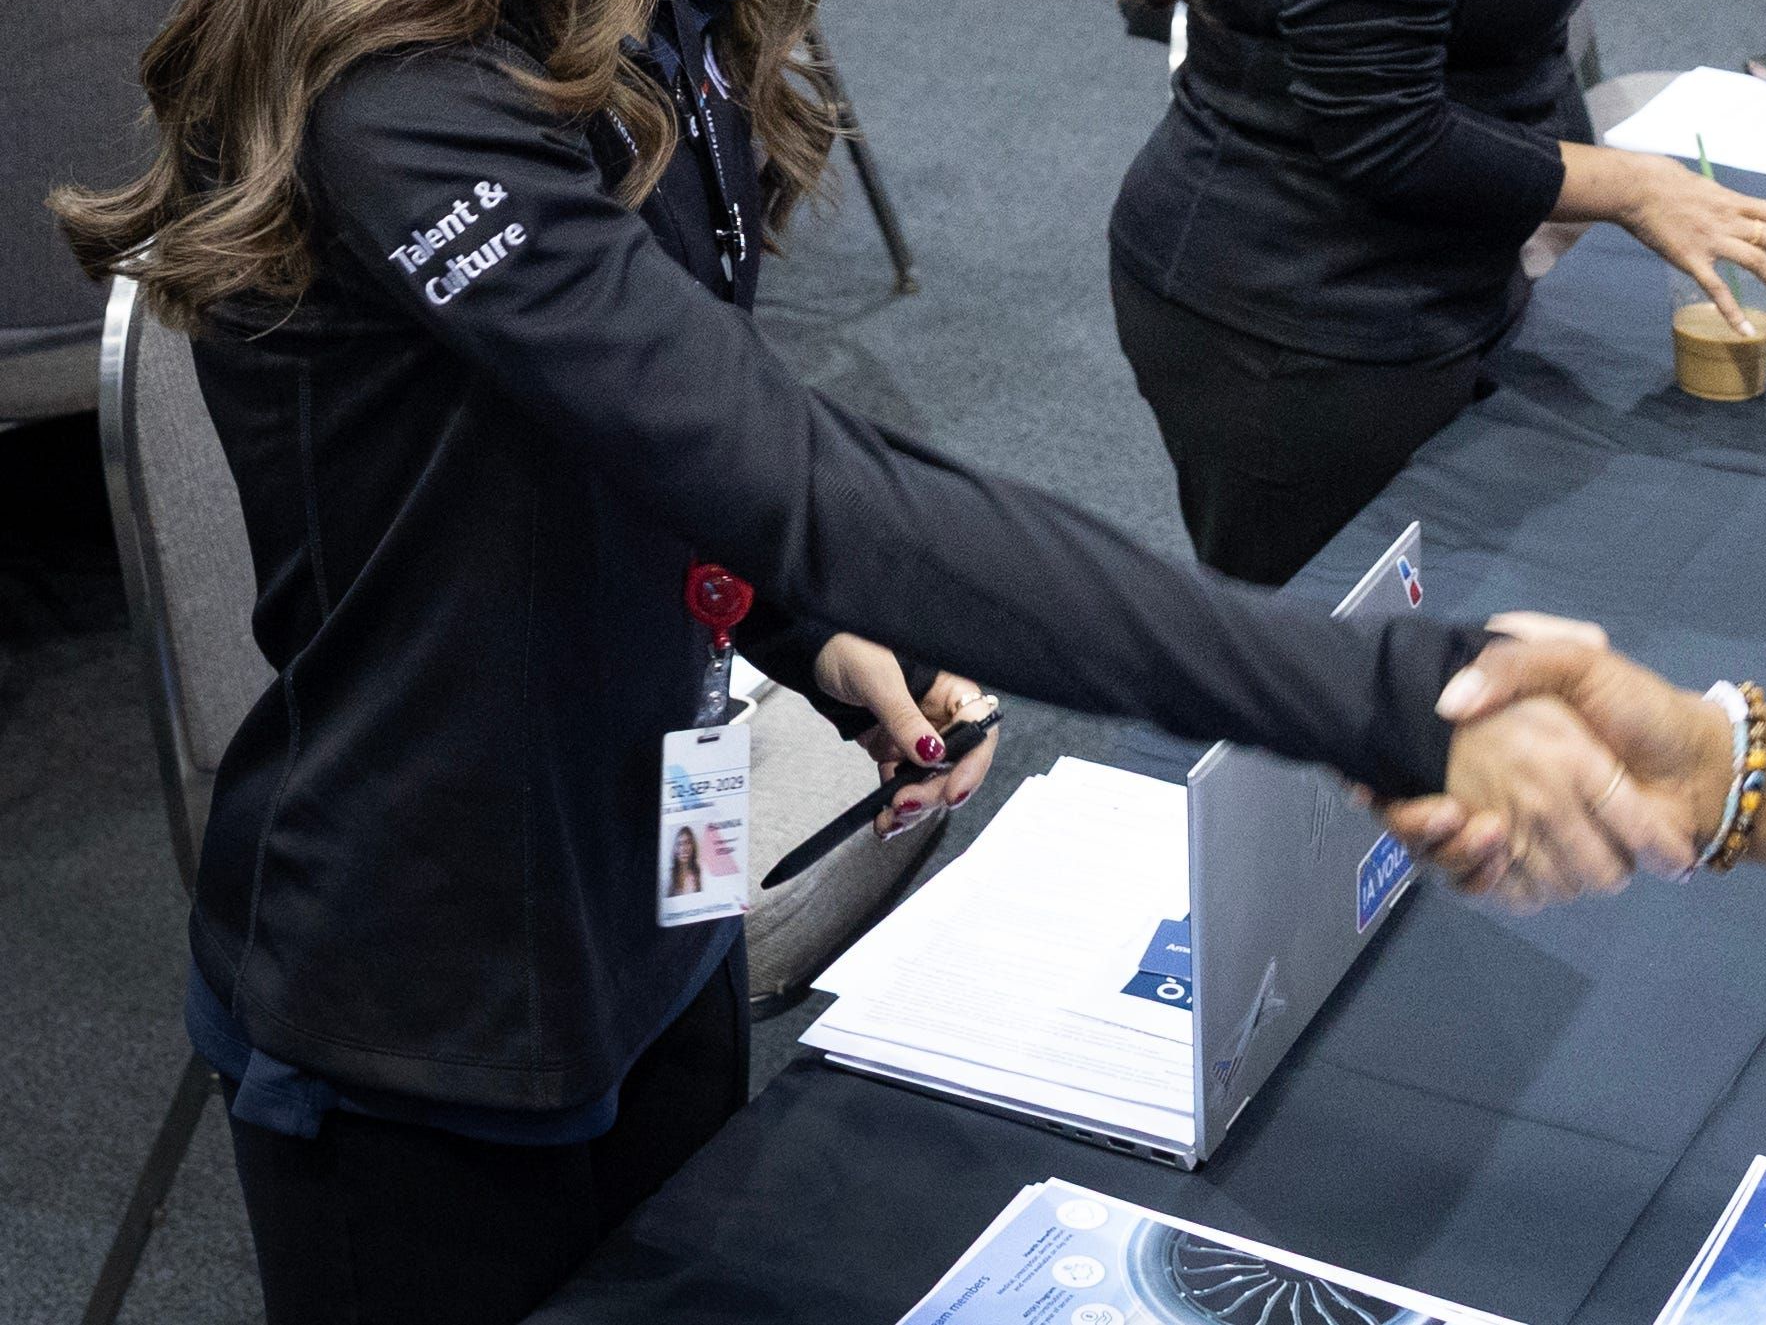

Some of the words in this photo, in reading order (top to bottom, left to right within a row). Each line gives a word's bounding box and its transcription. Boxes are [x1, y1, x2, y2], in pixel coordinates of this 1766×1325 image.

[388, 199, 480, 275] Talent
[473, 180, 509, 210] &
[424, 222, 528, 306] Culture
[949, 1275, 991, 1312] members
